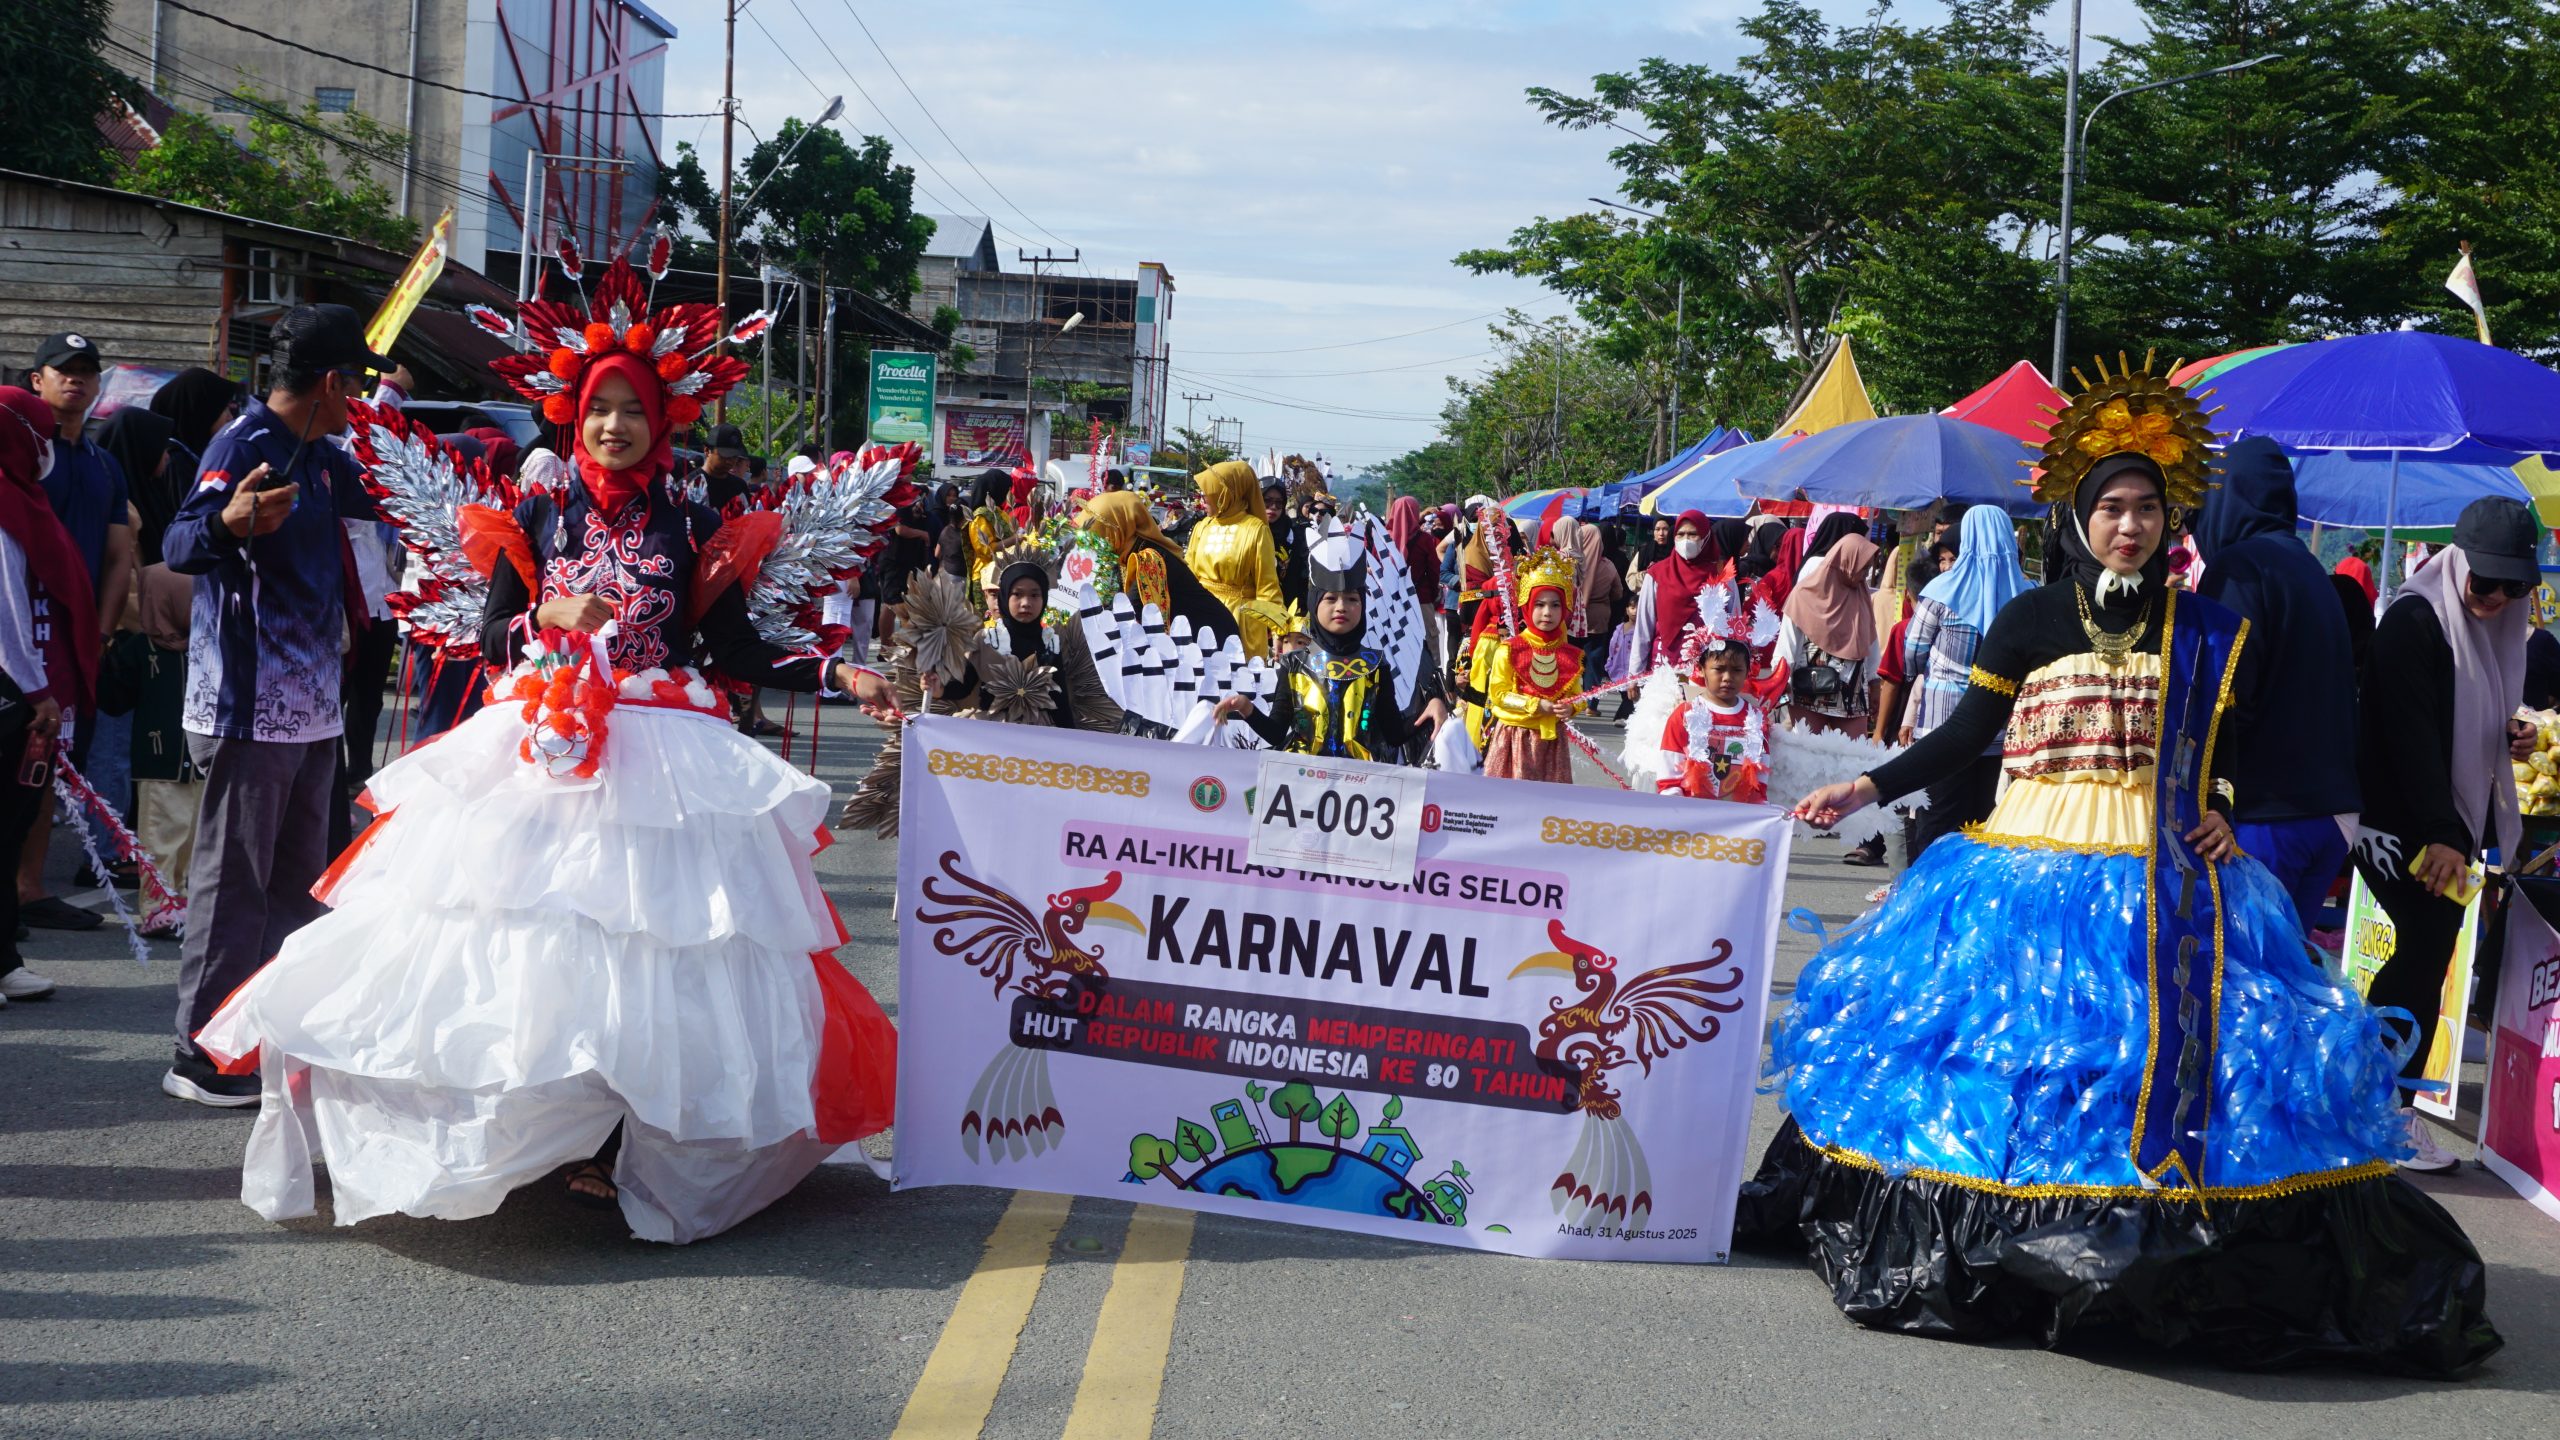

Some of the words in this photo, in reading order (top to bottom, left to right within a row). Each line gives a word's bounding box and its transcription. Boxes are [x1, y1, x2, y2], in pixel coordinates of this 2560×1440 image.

[878, 363, 927, 378] Procella
[876, 387, 908, 395] Wonderful
[878, 394, 911, 402] Wonderful
[1262, 784, 1396, 841] A-003
[1444, 809, 1467, 818] Bersatu
[1469, 813, 1497, 821] Berdaulat
[1442, 825, 1471, 833] Indonesia
[1472, 827, 1487, 835] Maju
[1443, 817, 1464, 825] Rakyat
[1465, 820, 1494, 828] Sejahtera
[1065, 831, 1108, 859] RA
[1458, 874, 1565, 910] SELOR
[1147, 894, 1490, 999] KARNAVAL
[1077, 991, 1176, 1025] DALAM
[1183, 1003, 1297, 1040] RANGKA
[1307, 1017, 1517, 1065] MEMPERINGATI
[1022, 1011, 1078, 1041] HUT
[1086, 1022, 1220, 1061] REPUBLIK
[1226, 1038, 1369, 1080] INDONESIA
[1379, 1057, 1418, 1084] KE
[1425, 1062, 1460, 1089] 80
[1471, 1068, 1566, 1102] TAHUN
[1557, 1223, 1594, 1238] Ahad,
[1597, 1226, 1612, 1238] 31
[1615, 1227, 1665, 1241] Agustus
[1667, 1228, 1698, 1240] 2025
